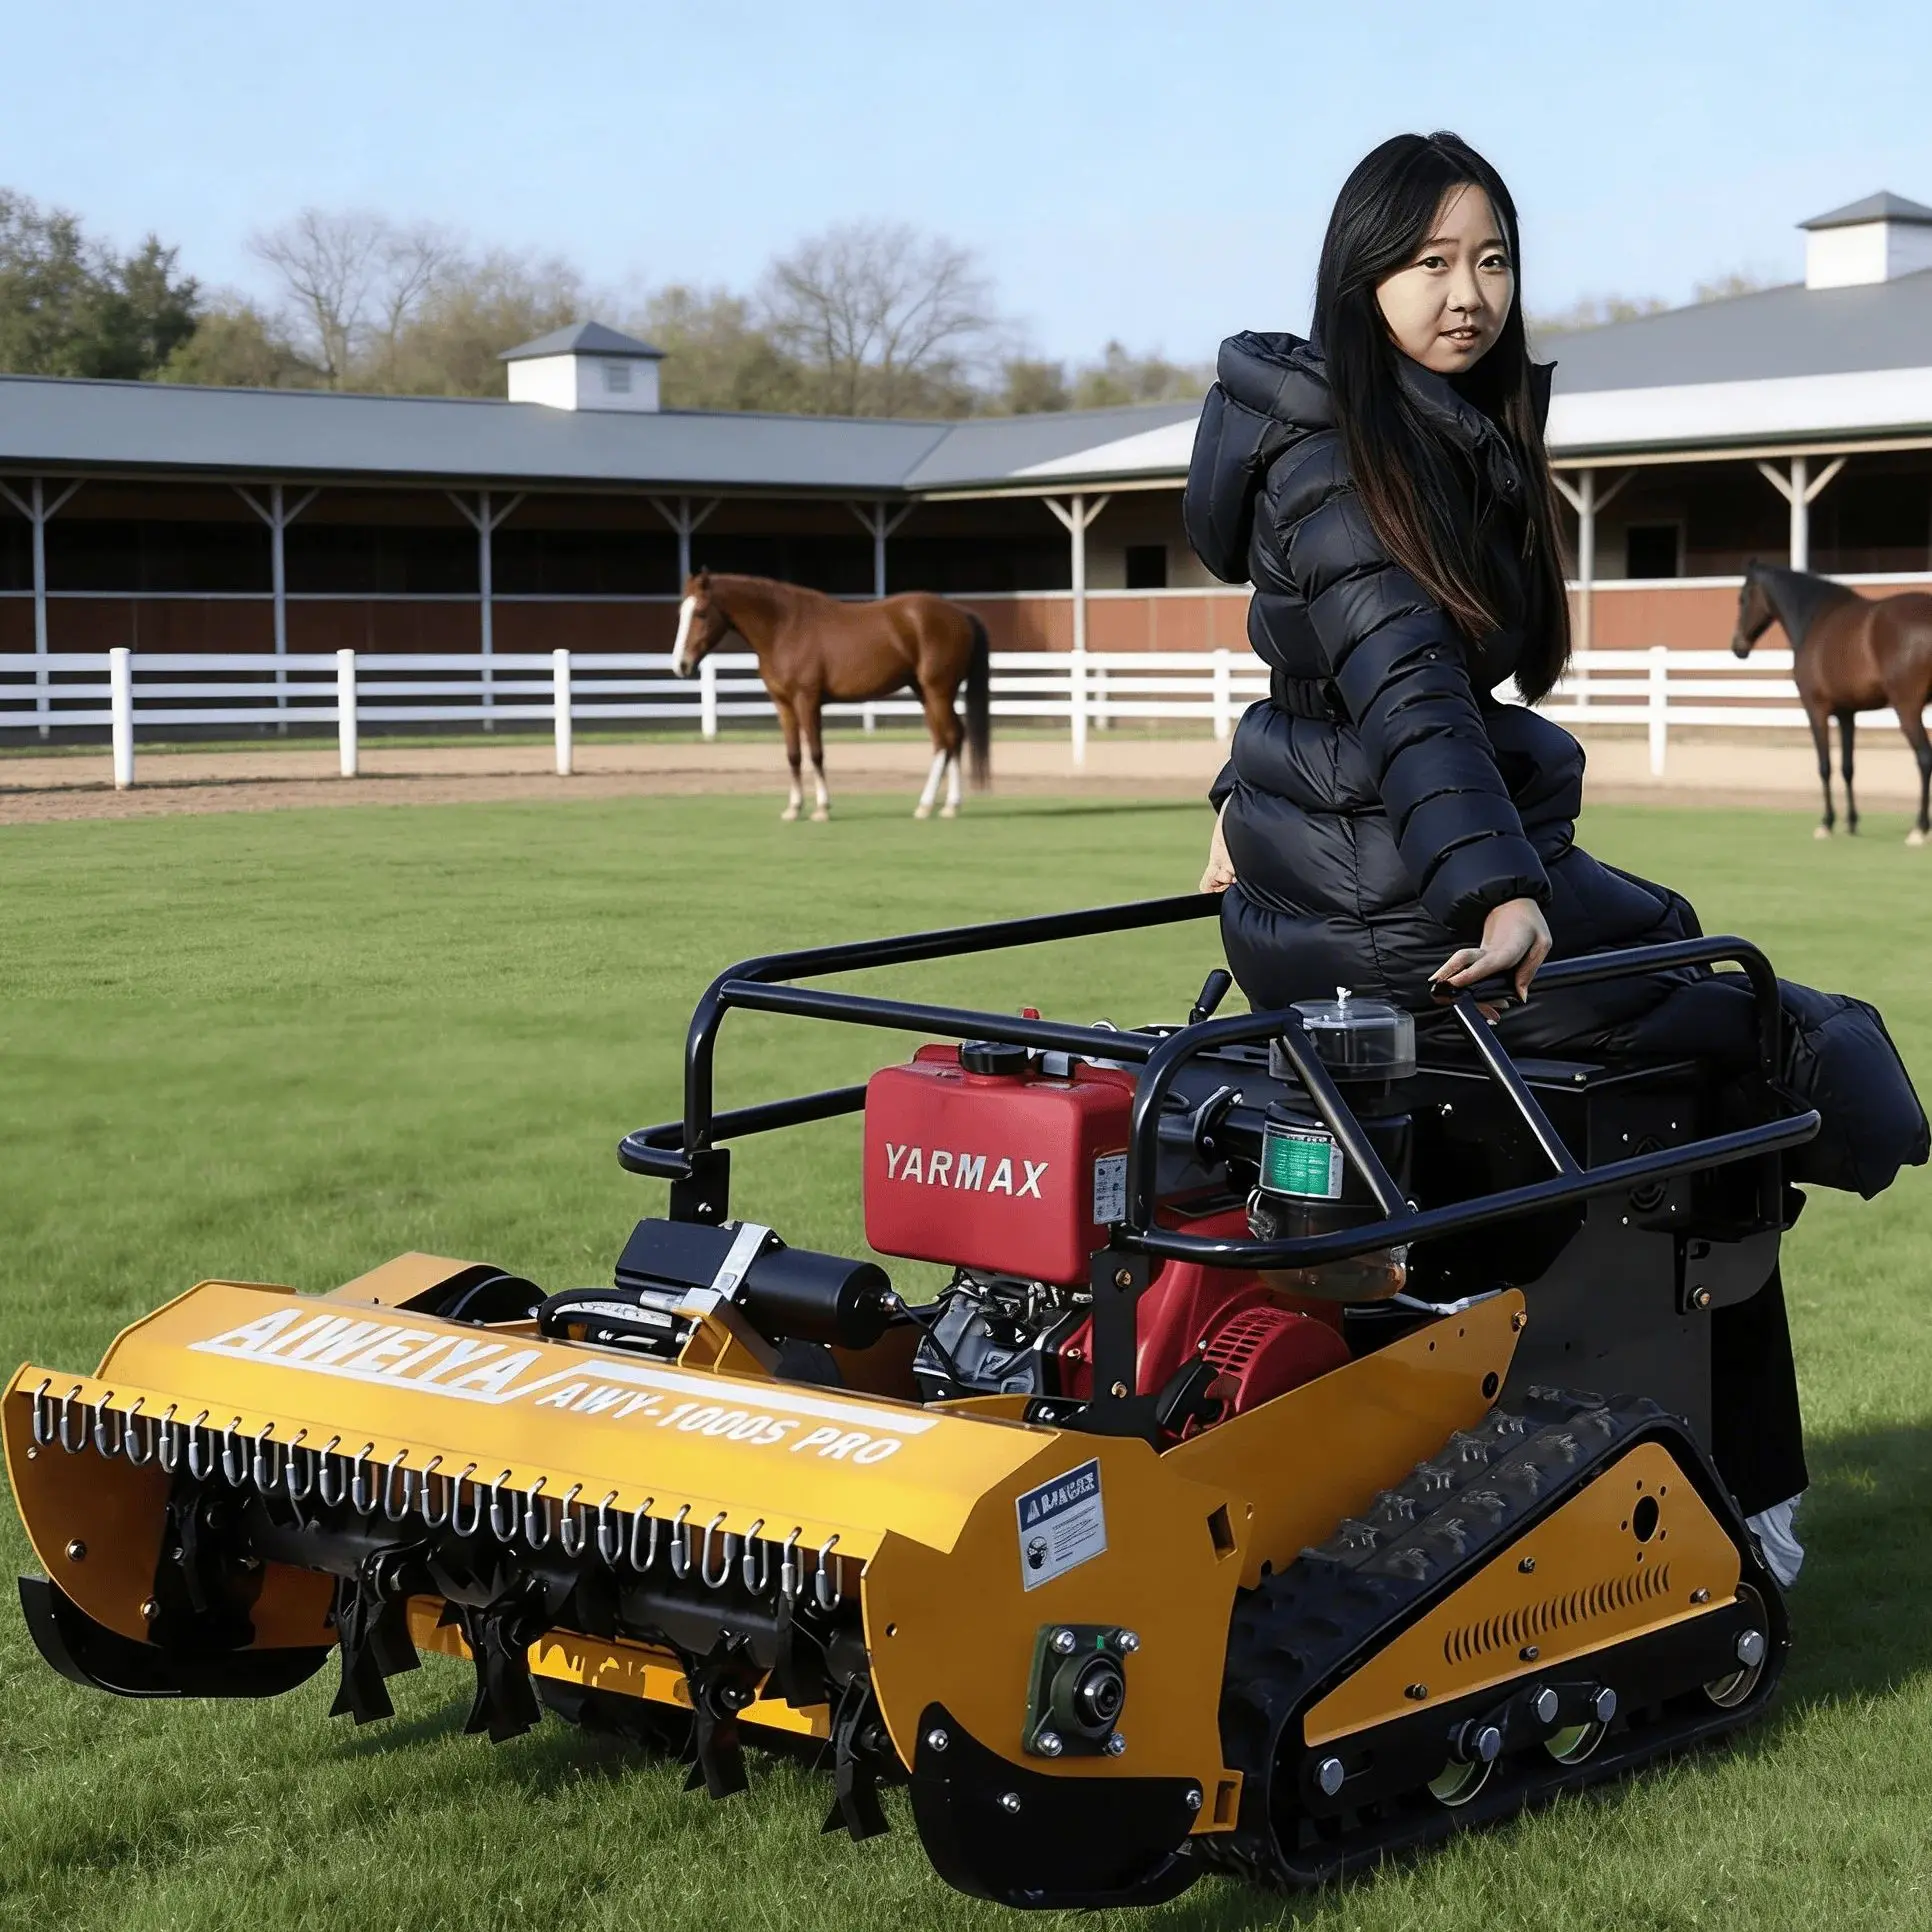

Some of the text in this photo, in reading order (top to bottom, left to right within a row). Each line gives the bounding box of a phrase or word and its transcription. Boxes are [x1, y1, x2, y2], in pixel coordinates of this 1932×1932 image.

[885, 1142, 1049, 1199] YARMAX
[200, 1308, 543, 1398] AIWEIYA
[535, 1382, 902, 1464] AWY-1000S PRO
